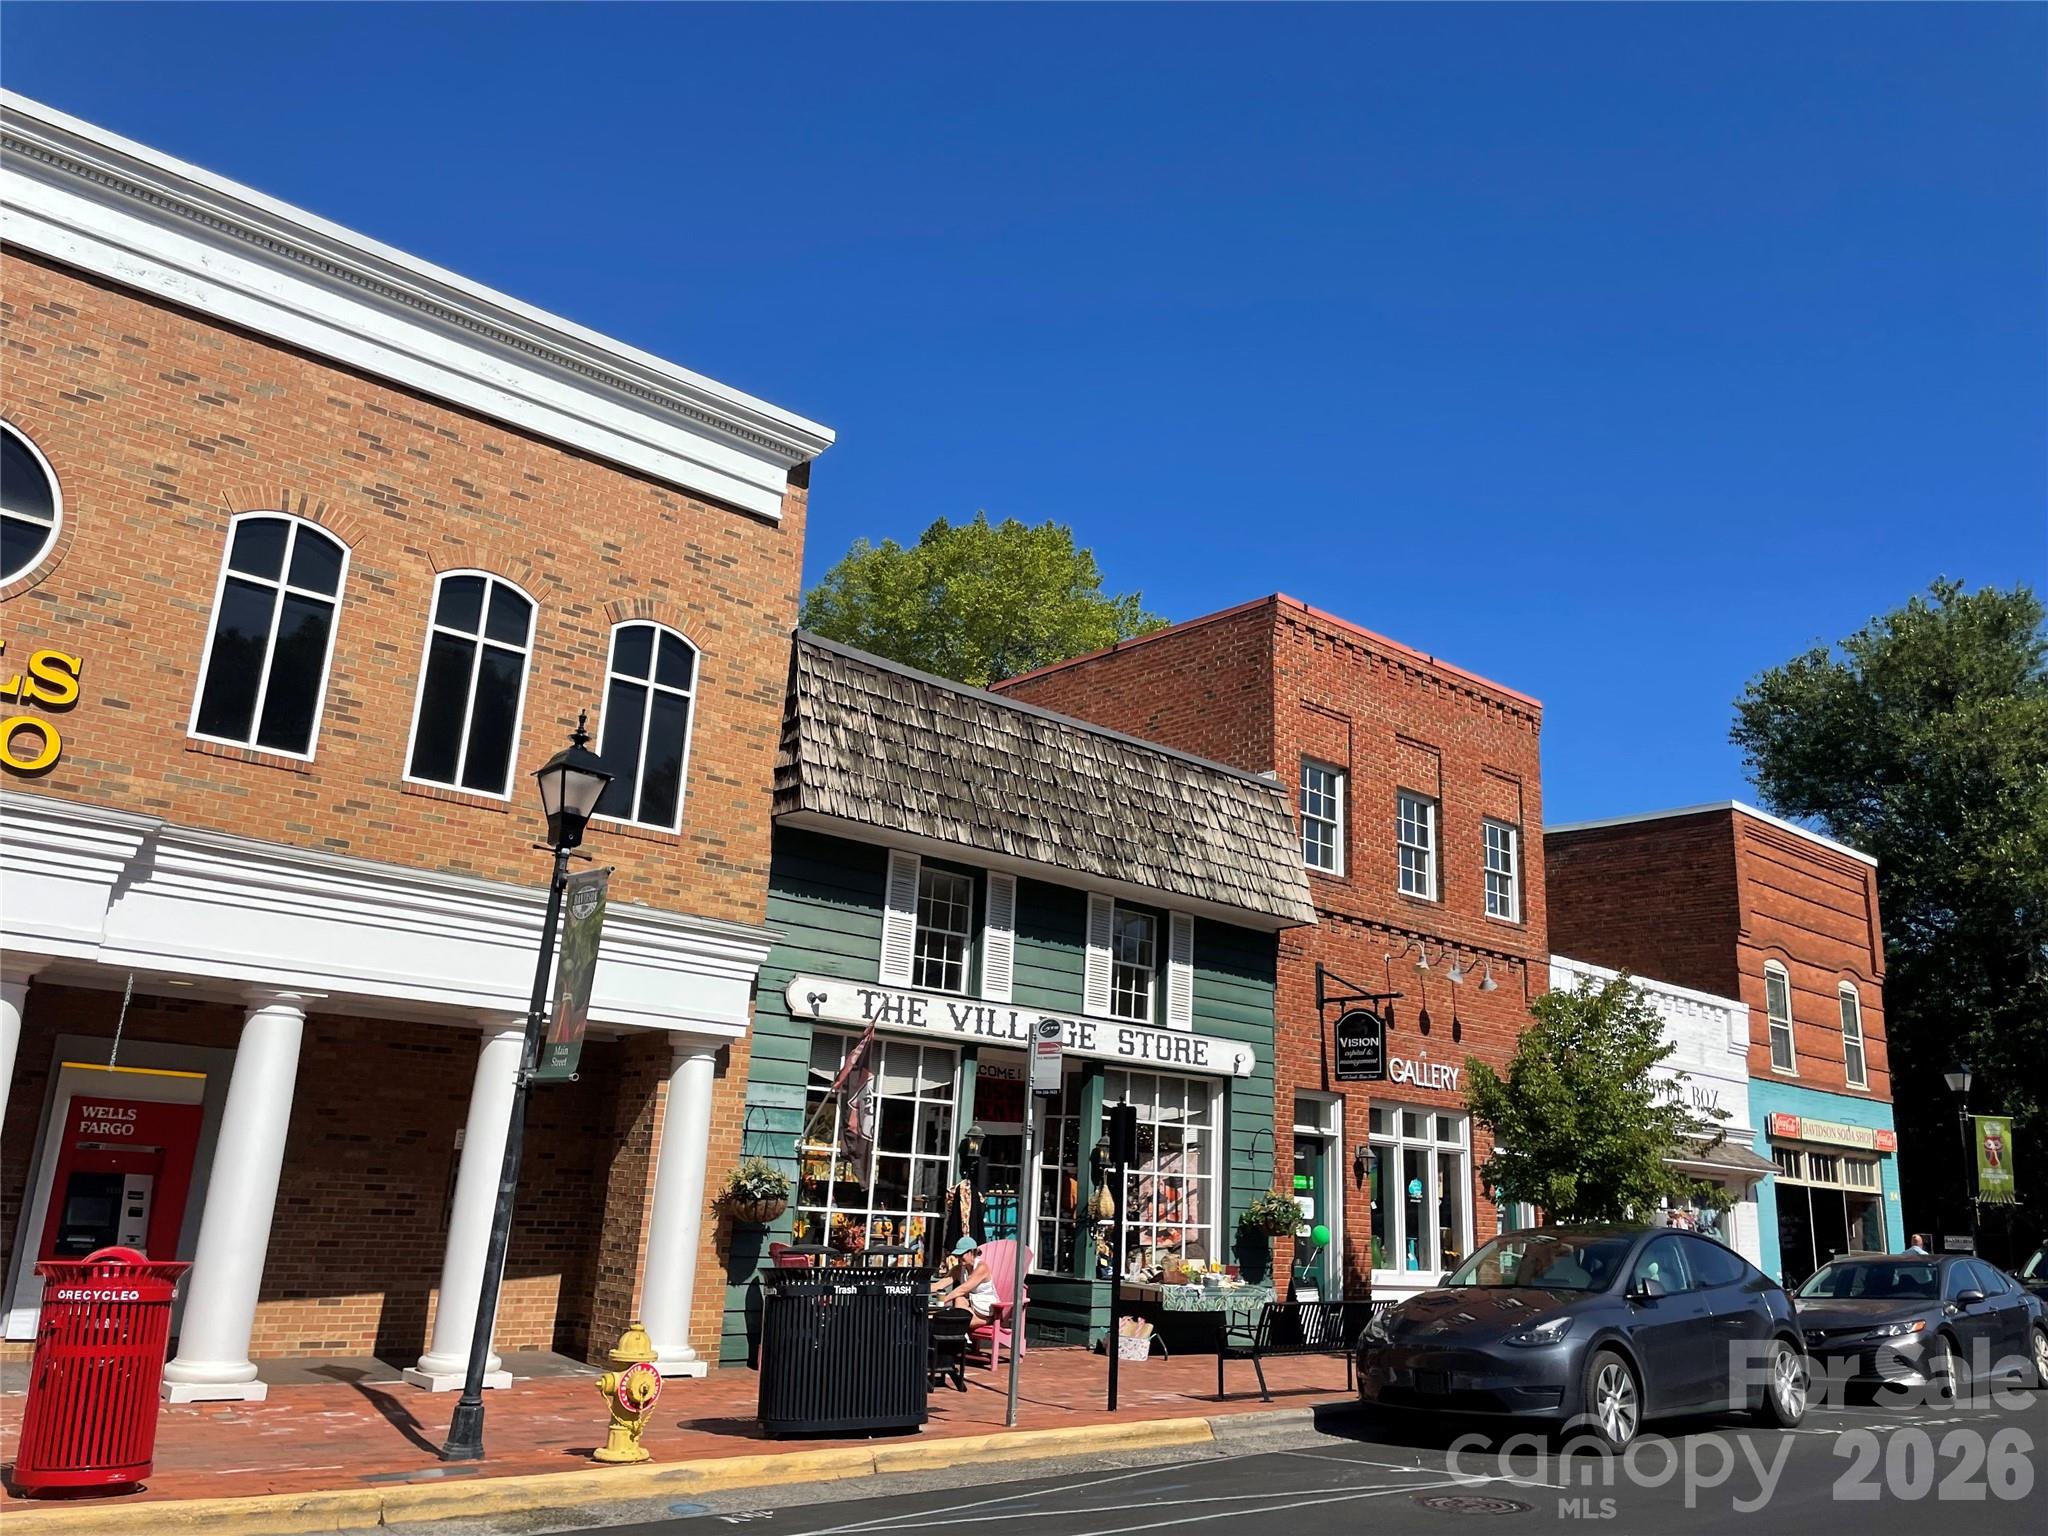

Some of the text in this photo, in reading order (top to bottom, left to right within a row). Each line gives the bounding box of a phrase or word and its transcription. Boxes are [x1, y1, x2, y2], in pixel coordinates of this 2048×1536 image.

[857, 989, 1209, 1066] THE VILLGE STORE
[1339, 1037, 1379, 1048] VISION
[554, 1045, 569, 1056] Main
[551, 1057, 567, 1067] Street
[976, 1065, 1021, 1079] COME!
[1389, 1057, 1459, 1091] GALLERY
[1691, 1086, 1719, 1109] BOX
[82, 1106, 137, 1120] WELLS
[79, 1121, 135, 1136] FARGO
[1803, 1122, 1872, 1145] DAVIDSON SODA SHOP
[66, 1290, 129, 1301] RECYCLE
[834, 1285, 857, 1295] Trash
[884, 1286, 912, 1295] TRASH
